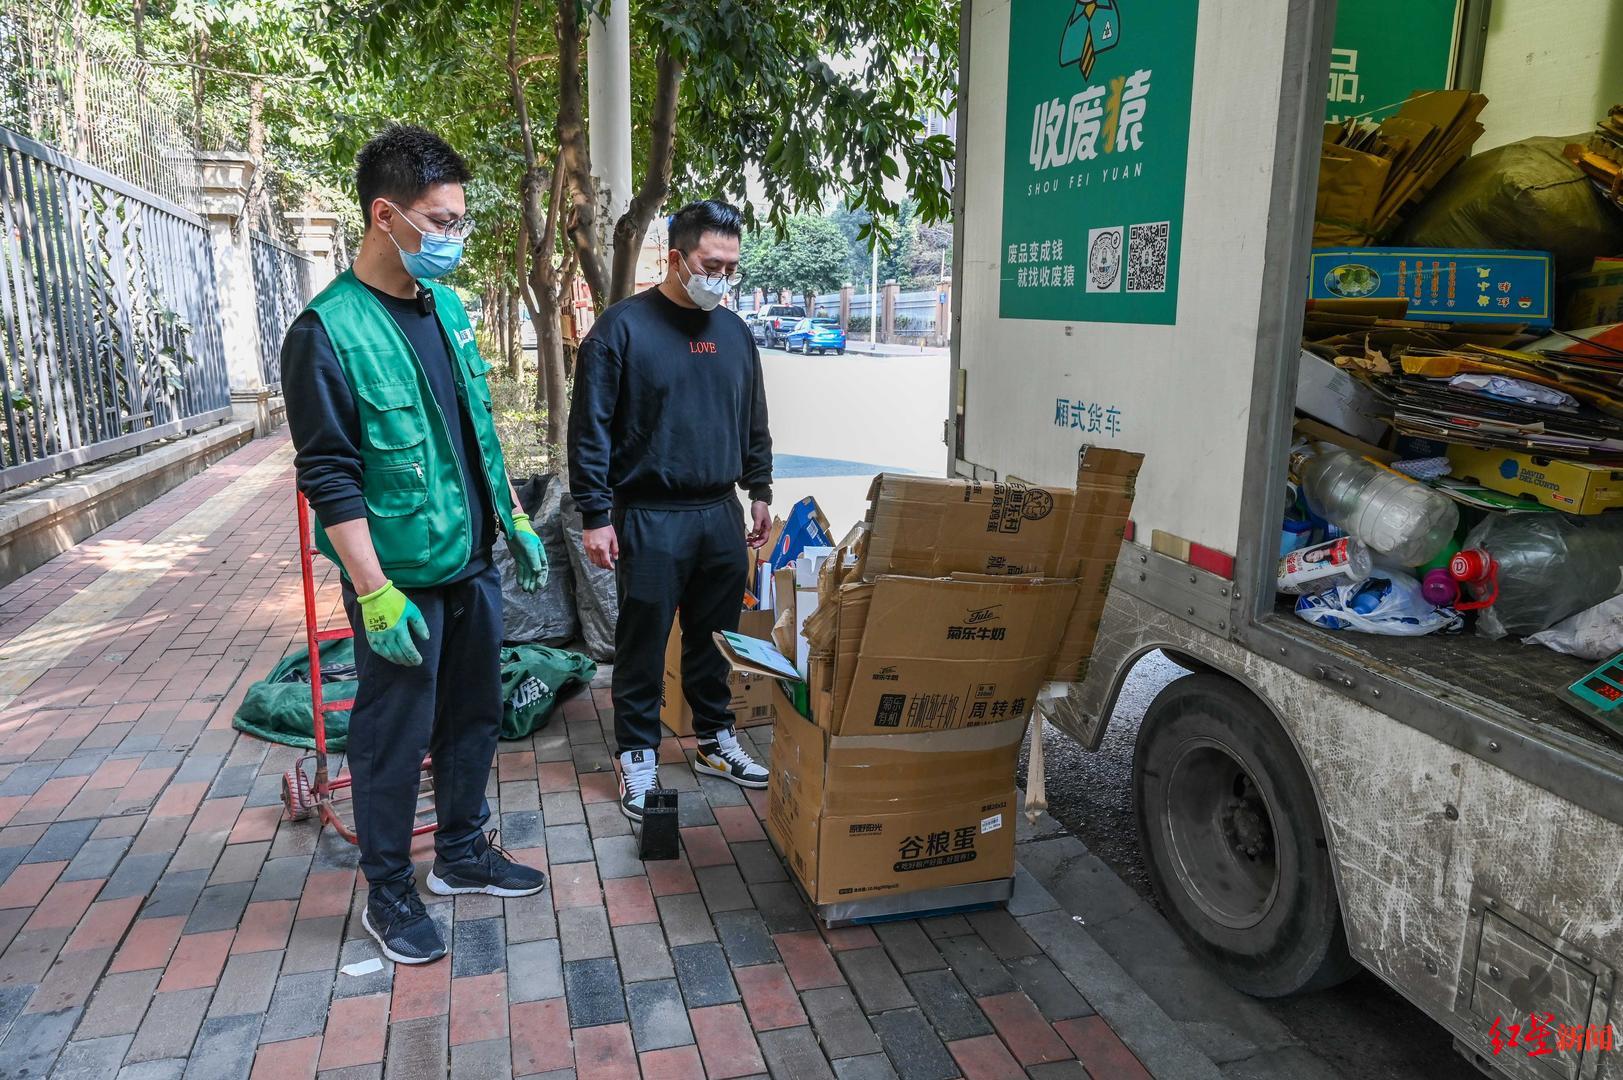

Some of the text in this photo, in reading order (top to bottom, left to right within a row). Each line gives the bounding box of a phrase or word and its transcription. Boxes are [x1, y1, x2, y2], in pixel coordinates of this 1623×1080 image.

[1029, 69, 1152, 171] 收废猿
[1027, 162, 1143, 197] SHOU FEI YUAN
[1007, 239, 1063, 264] 废品变成钱
[1017, 265, 1075, 288] 就找收废猿
[689, 342, 717, 354] LOVE
[1054, 398, 1121, 438] 厢式货车
[1518, 475, 1533, 485] DEL
[1521, 468, 1545, 480] DAVID
[986, 482, 1004, 533] 品质鸡蛋
[947, 626, 1006, 641] 菊乐牛奶
[968, 697, 1027, 720] 周转箱
[849, 823, 883, 834] 原野阳光
[898, 826, 977, 860] 谷粮蛋
